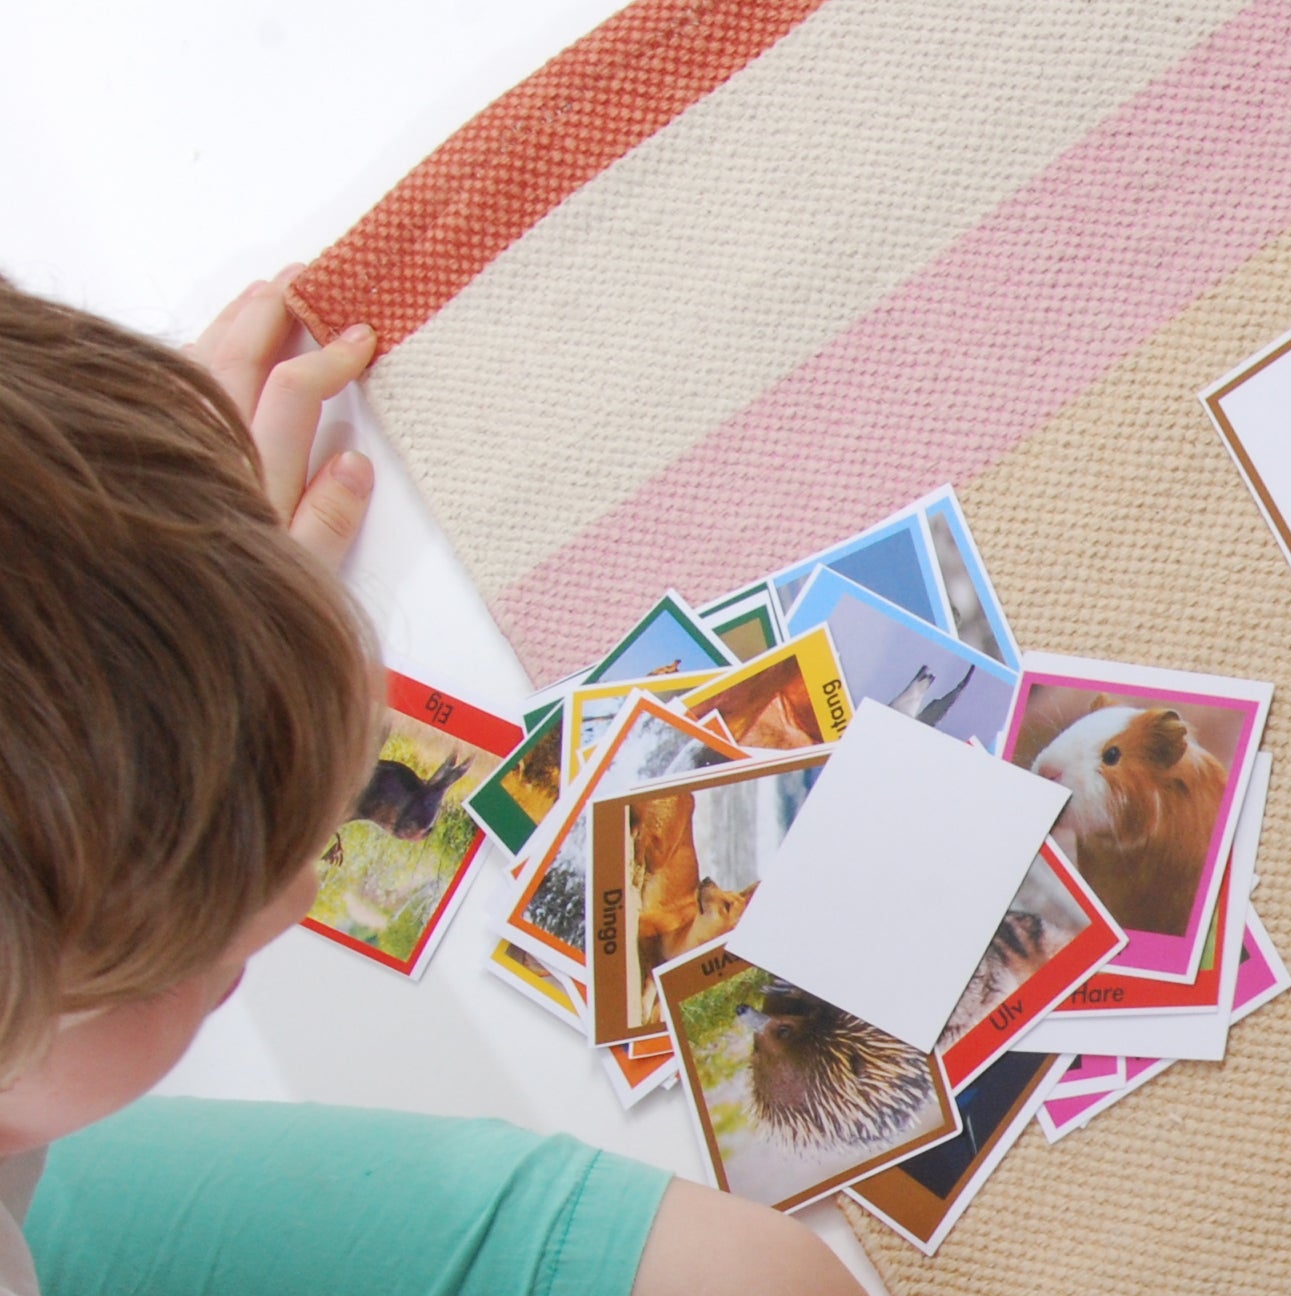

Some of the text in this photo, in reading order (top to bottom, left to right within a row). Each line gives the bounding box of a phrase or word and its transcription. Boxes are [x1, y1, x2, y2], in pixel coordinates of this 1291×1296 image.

[425, 690, 454, 725] Elg
[598, 888, 623, 955] Dingo
[1070, 983, 1125, 1004] Hare
[989, 1000, 1023, 1031] Ulv
